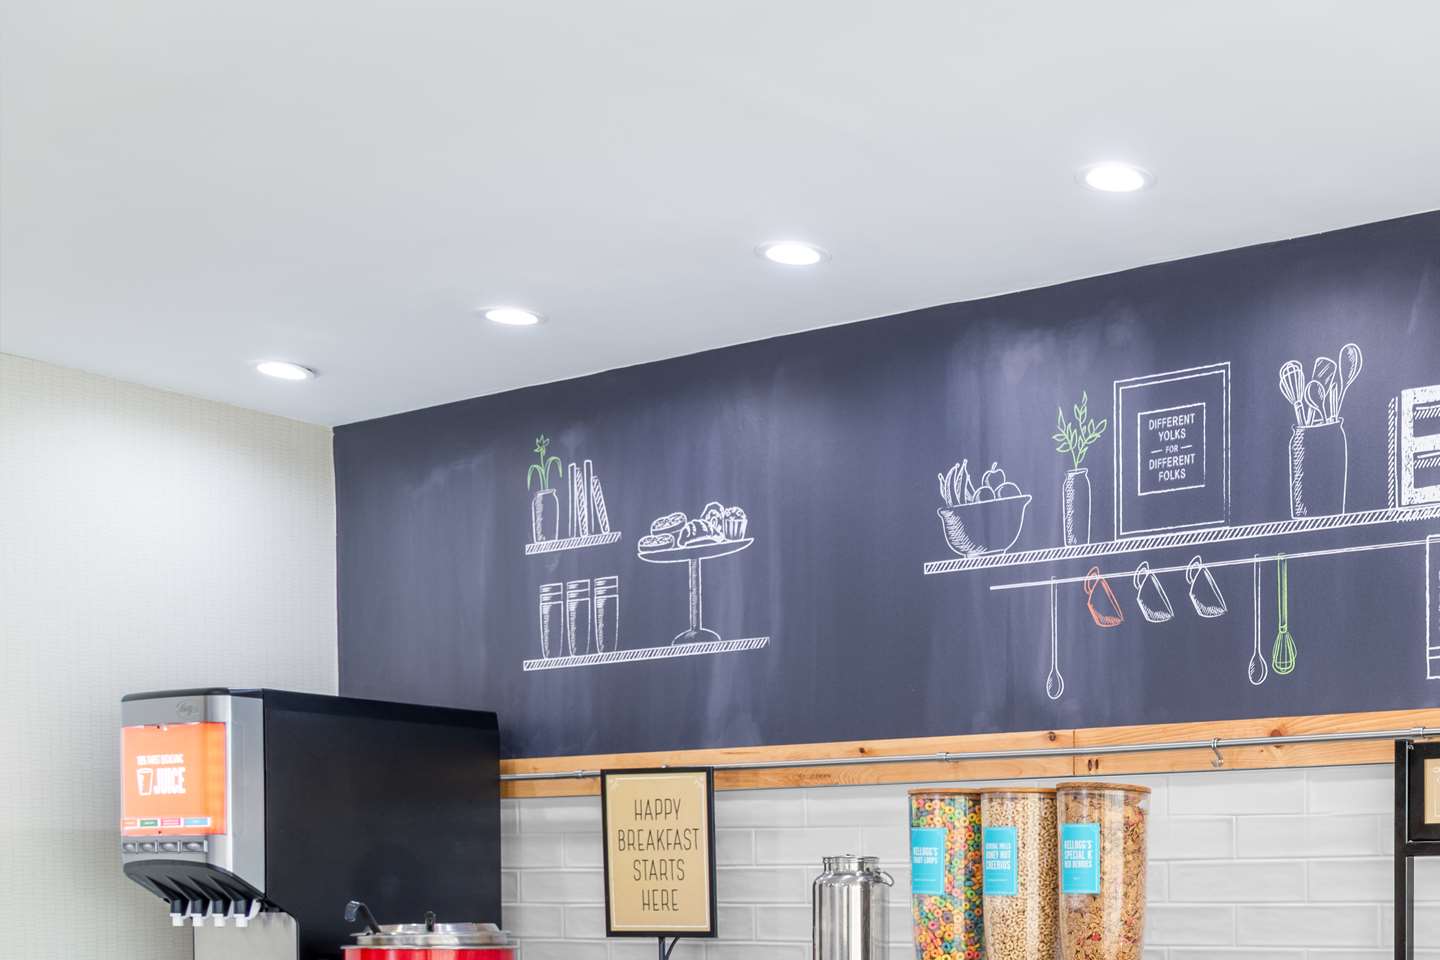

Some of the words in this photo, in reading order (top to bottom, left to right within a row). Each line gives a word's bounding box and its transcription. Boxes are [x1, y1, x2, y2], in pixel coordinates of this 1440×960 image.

[1148, 413, 1196, 430] DIFFERENT
[1158, 428, 1186, 442] YOLKS
[1165, 445, 1179, 454] FOR
[1148, 453, 1196, 470] DIFFERENT
[1158, 468, 1186, 482] FOLKS
[634, 798, 681, 821] HAPPY
[618, 828, 699, 851] BREAKFAST
[633, 858, 685, 881] STARTS
[641, 889, 680, 912] HERE
